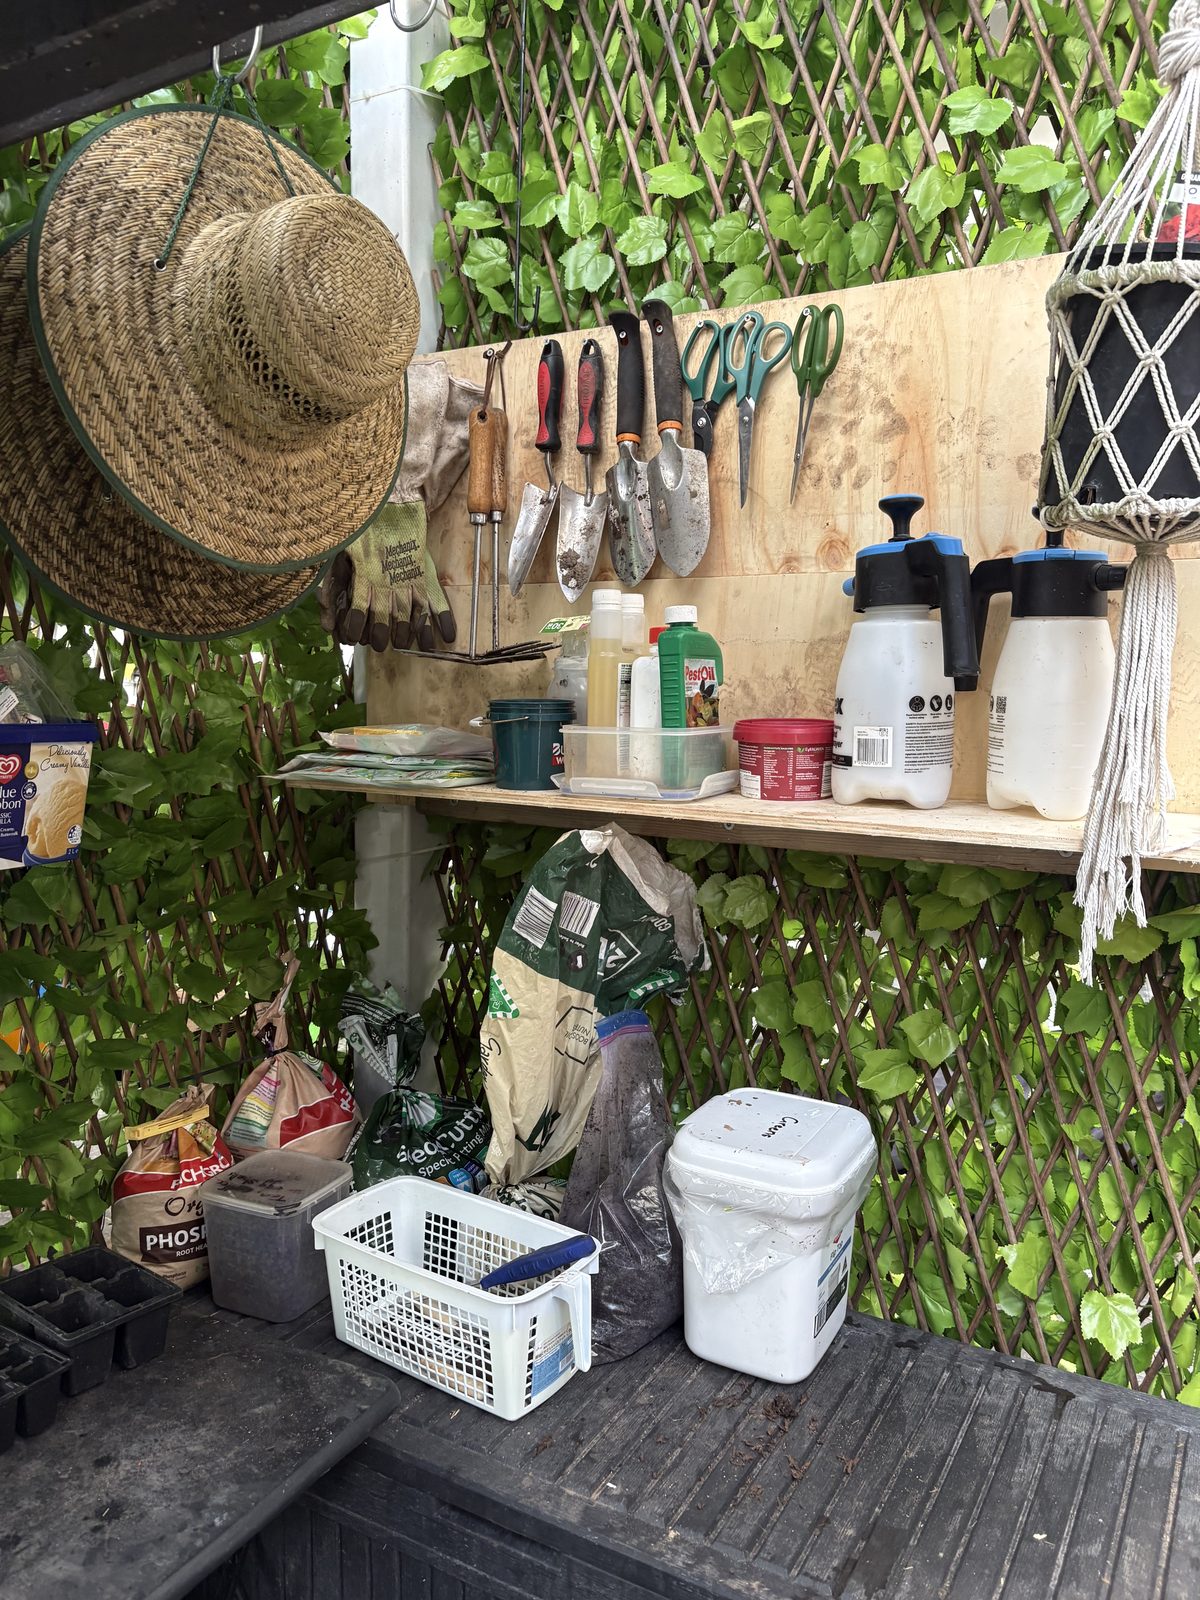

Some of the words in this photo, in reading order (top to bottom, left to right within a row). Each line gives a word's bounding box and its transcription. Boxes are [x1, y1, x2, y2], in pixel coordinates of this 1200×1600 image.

[48, 744, 87, 759] Deliciously
[40, 758, 70, 773] Creamy
[0, 785, 17, 798] lue
[0, 798, 21, 810] bon
[176, 1247, 194, 1258] ROOT
[195, 1242, 208, 1253] HEA
